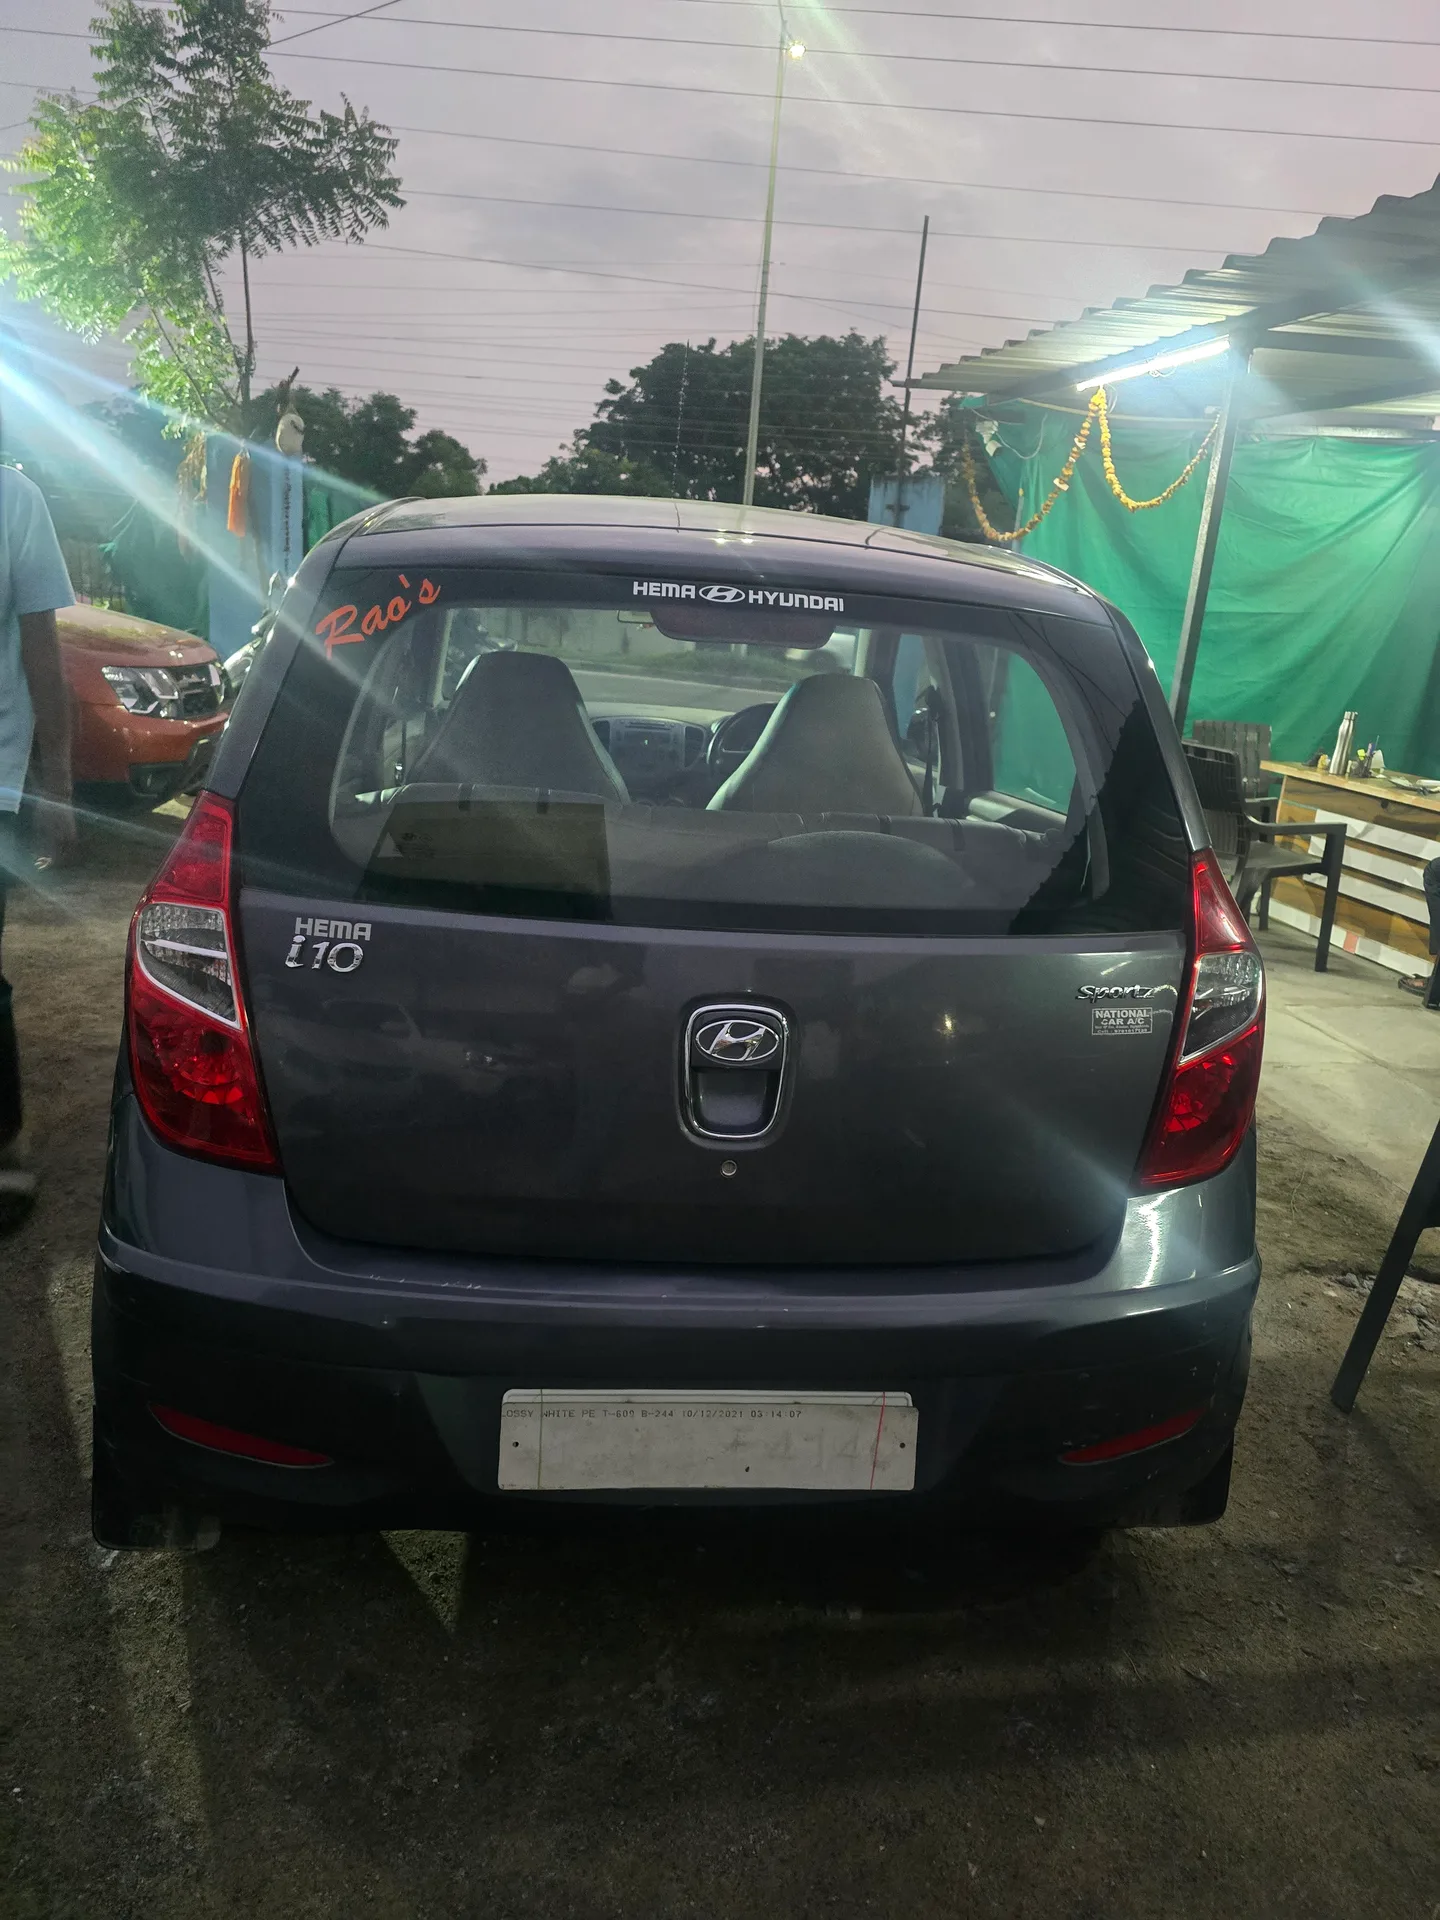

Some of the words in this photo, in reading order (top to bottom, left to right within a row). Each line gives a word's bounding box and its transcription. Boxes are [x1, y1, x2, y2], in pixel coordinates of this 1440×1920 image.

[633, 581, 696, 599] HEMA
[748, 590, 844, 612] HYUNDAI
[315, 573, 441, 660] Rao's
[294, 917, 372, 941] HEMA
[285, 935, 364, 973] i10
[1077, 984, 1155, 1004] Sportz
[1095, 1009, 1150, 1019] NATIONAL
[1127, 1017, 1145, 1025] A/C
[581, 1409, 596, 1418] PE
[641, 1409, 674, 1418] B-244
